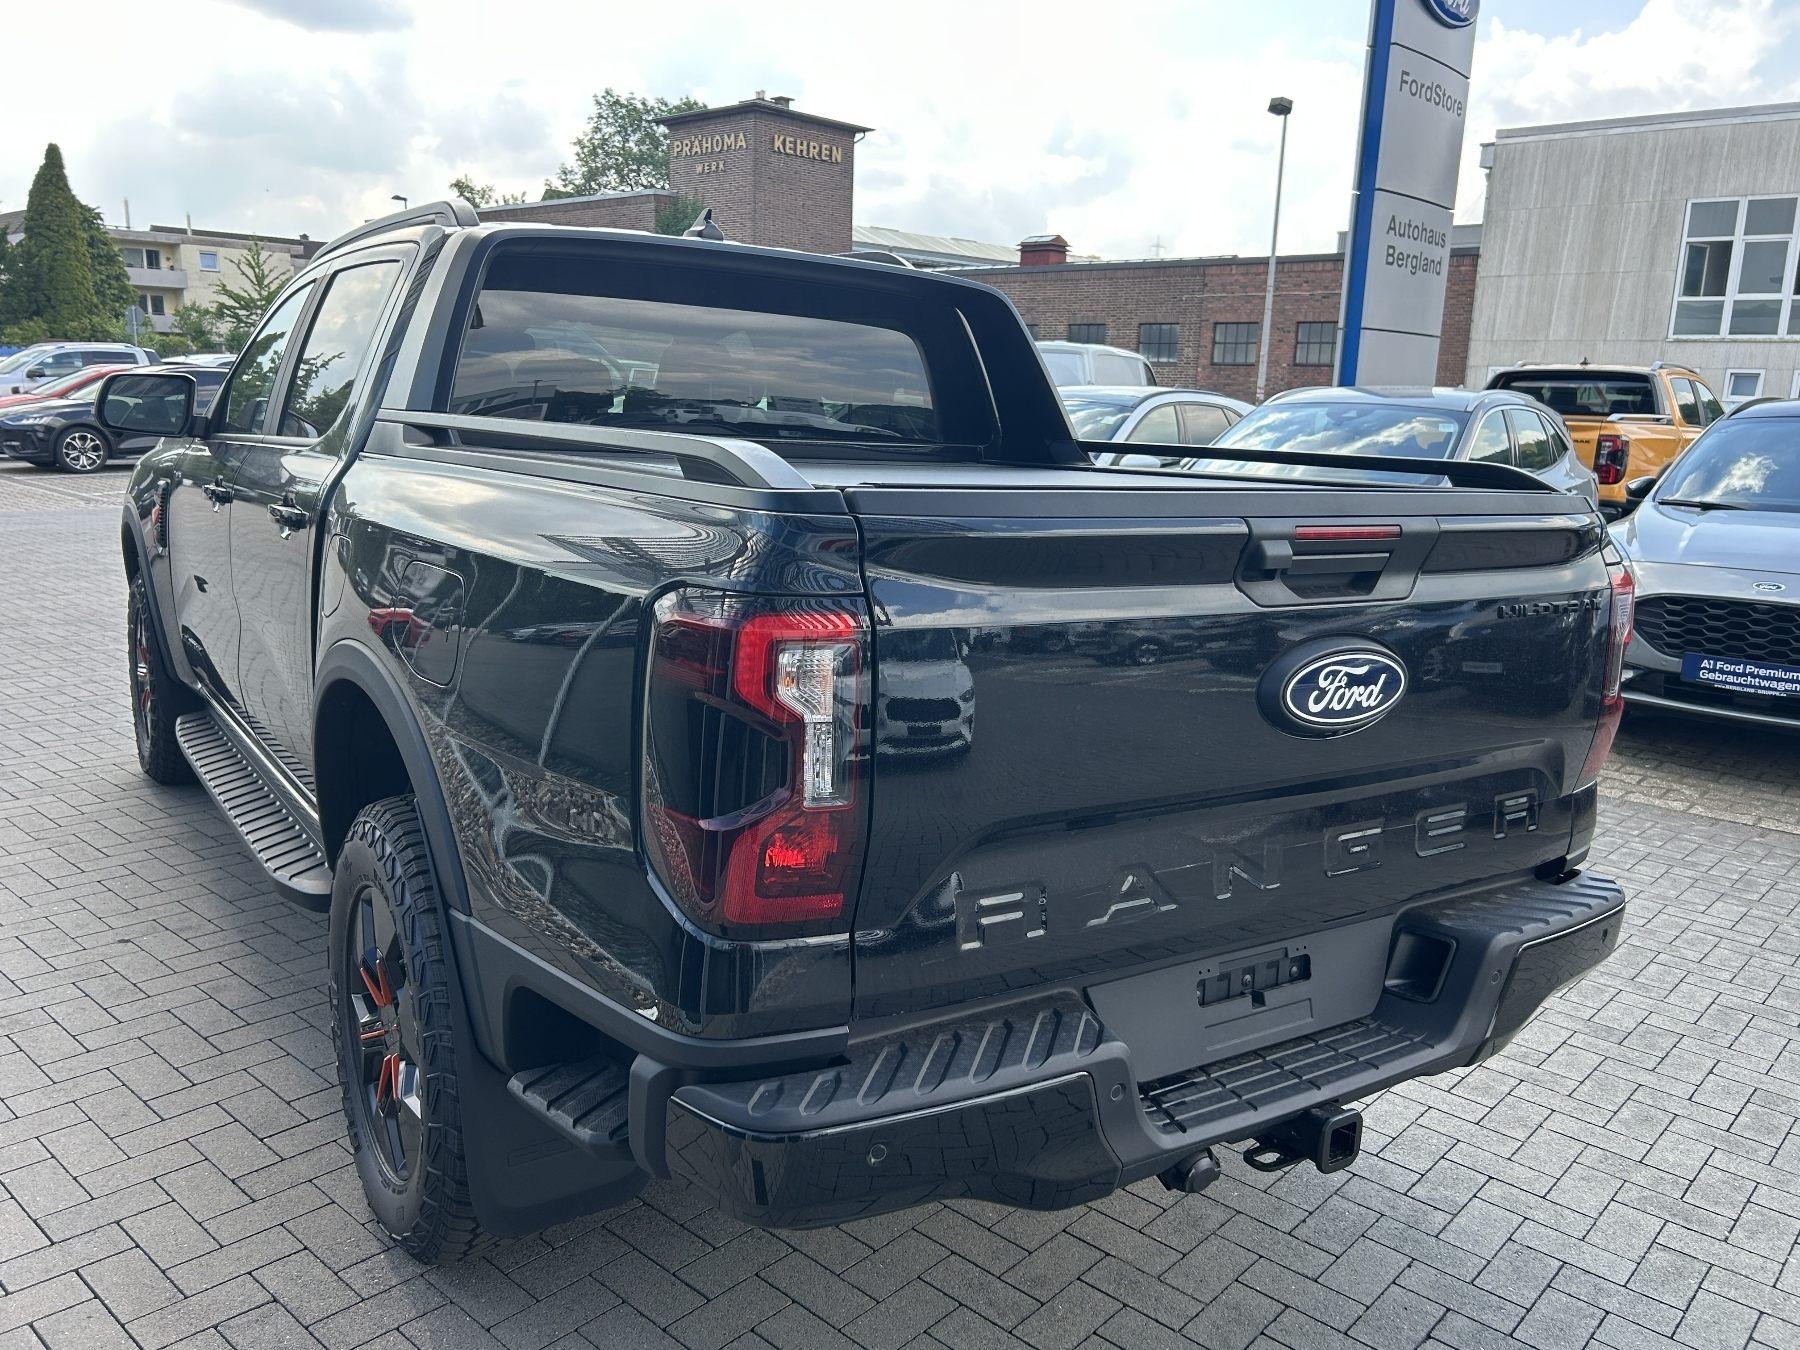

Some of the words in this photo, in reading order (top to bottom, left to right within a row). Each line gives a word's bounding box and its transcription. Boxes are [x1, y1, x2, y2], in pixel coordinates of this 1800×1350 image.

[1399, 69, 1463, 117] FordStore
[672, 132, 747, 157] PRÄHOMA
[774, 134, 842, 163] KEHREN
[695, 160, 725, 175] WERK
[1386, 214, 1446, 248] Autohaus
[1385, 244, 1442, 276] Bergland
[1699, 669, 1800, 691] Gebrauchtwagen
[1701, 659, 1713, 669] A1
[1716, 661, 1743, 673] Ford
[1745, 665, 1800, 681] Premium
[1308, 664, 1387, 713] Ford
[956, 786, 1540, 951] RANGER
